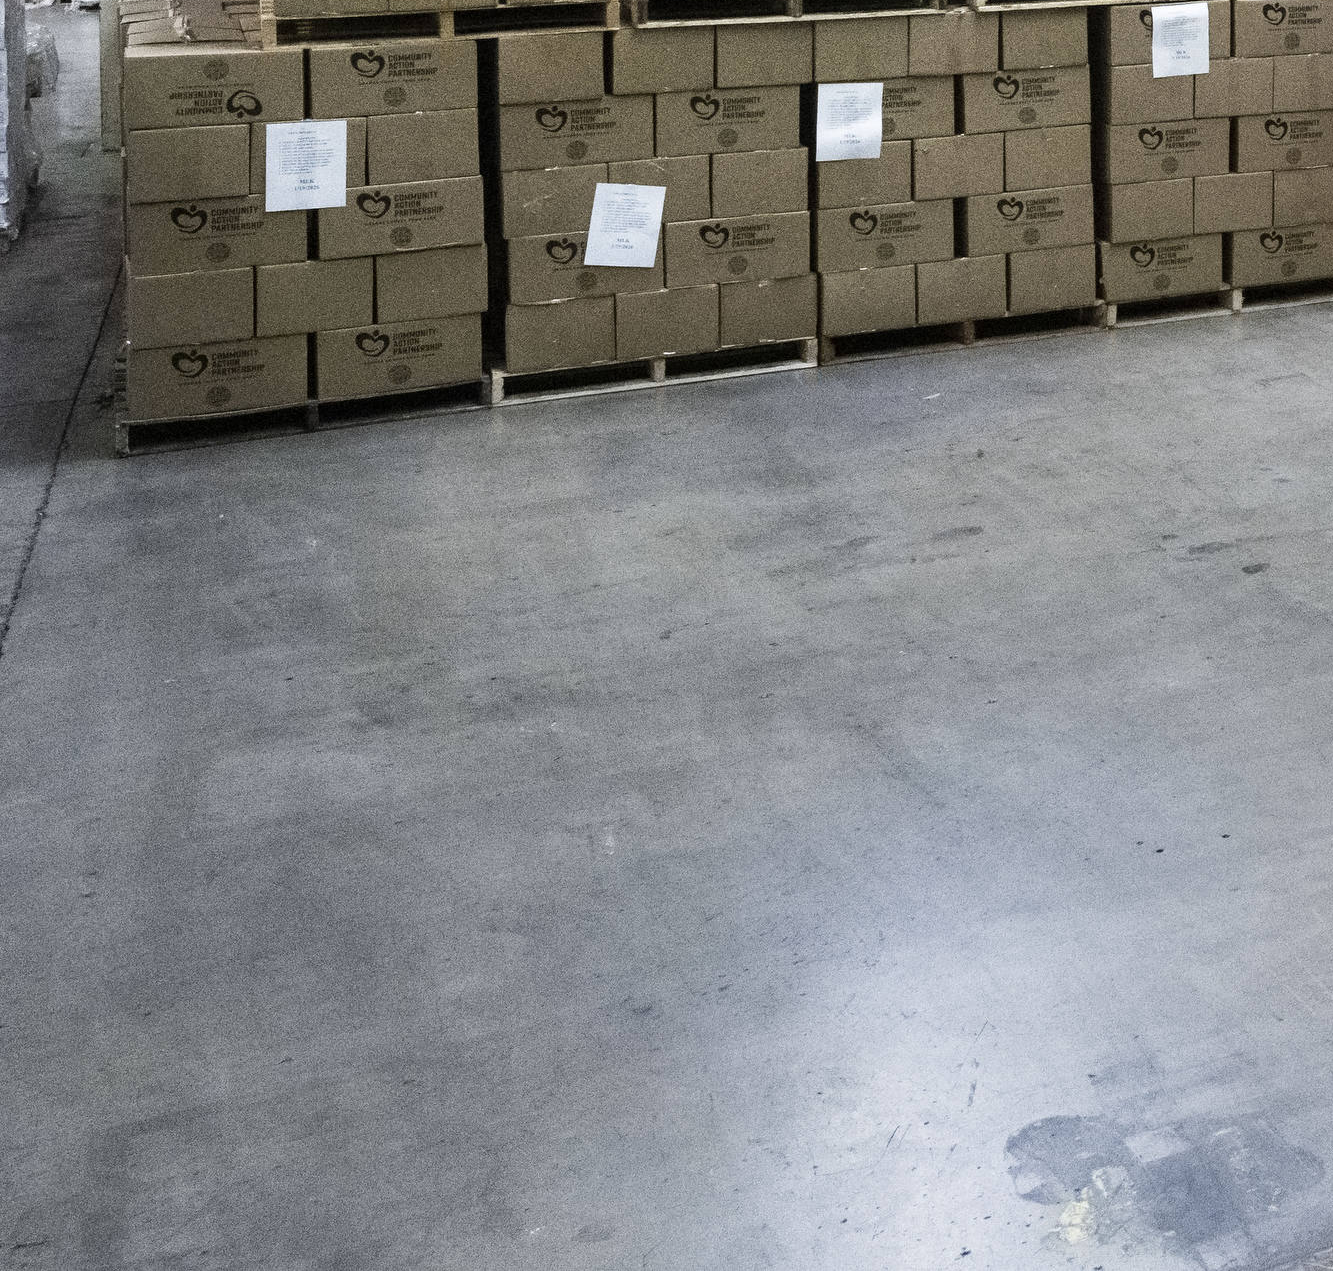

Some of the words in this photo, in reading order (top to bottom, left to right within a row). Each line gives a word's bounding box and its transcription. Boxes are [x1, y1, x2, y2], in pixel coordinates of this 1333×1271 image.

[388, 52, 431, 61] COMMUNITY
[388, 67, 437, 76] PARTNERSHIP
[169, 90, 222, 99] PARTNERSHIP
[723, 96, 760, 104] COMMUNITY
[175, 106, 221, 115] COMMUNITY
[571, 107, 610, 116] COMMUNITY
[722, 110, 765, 119] PARTNERSHIP
[570, 121, 616, 131] PARTNERSHIP
[394, 191, 437, 201] COMMUNITY
[210, 205, 259, 217] COMMUNITY
[394, 205, 443, 216] PARTNERSHIP
[210, 220, 264, 232] PARTNERSHIP
[393, 328, 436, 339] COMMUNITY
[393, 342, 442, 354] PARTNERSHIP
[212, 348, 258, 360] COMMUNITY
[211, 363, 264, 376] PARTNERSHIP
